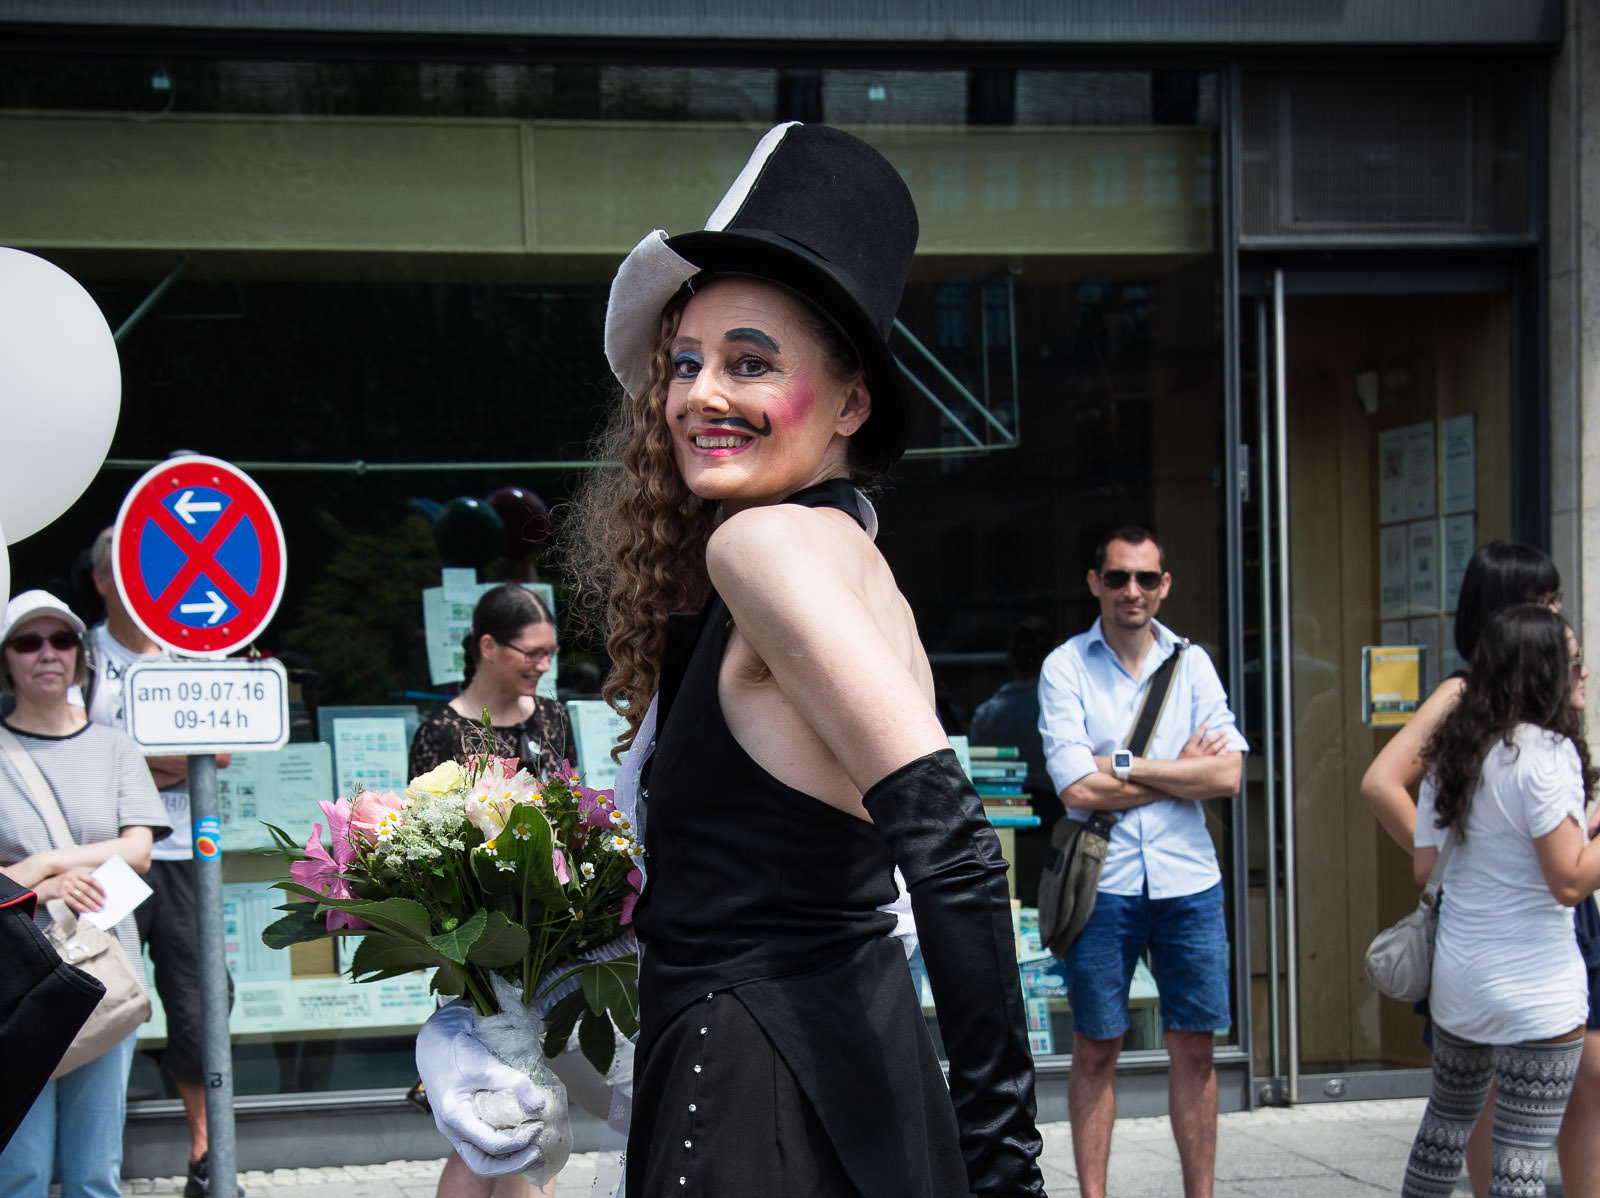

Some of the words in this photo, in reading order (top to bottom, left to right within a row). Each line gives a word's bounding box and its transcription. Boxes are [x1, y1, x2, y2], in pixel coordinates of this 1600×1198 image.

[138, 686, 171, 701] am
[178, 682, 265, 701] 09.07.16
[174, 710, 231, 729] 09-14
[236, 709, 249, 728] h
